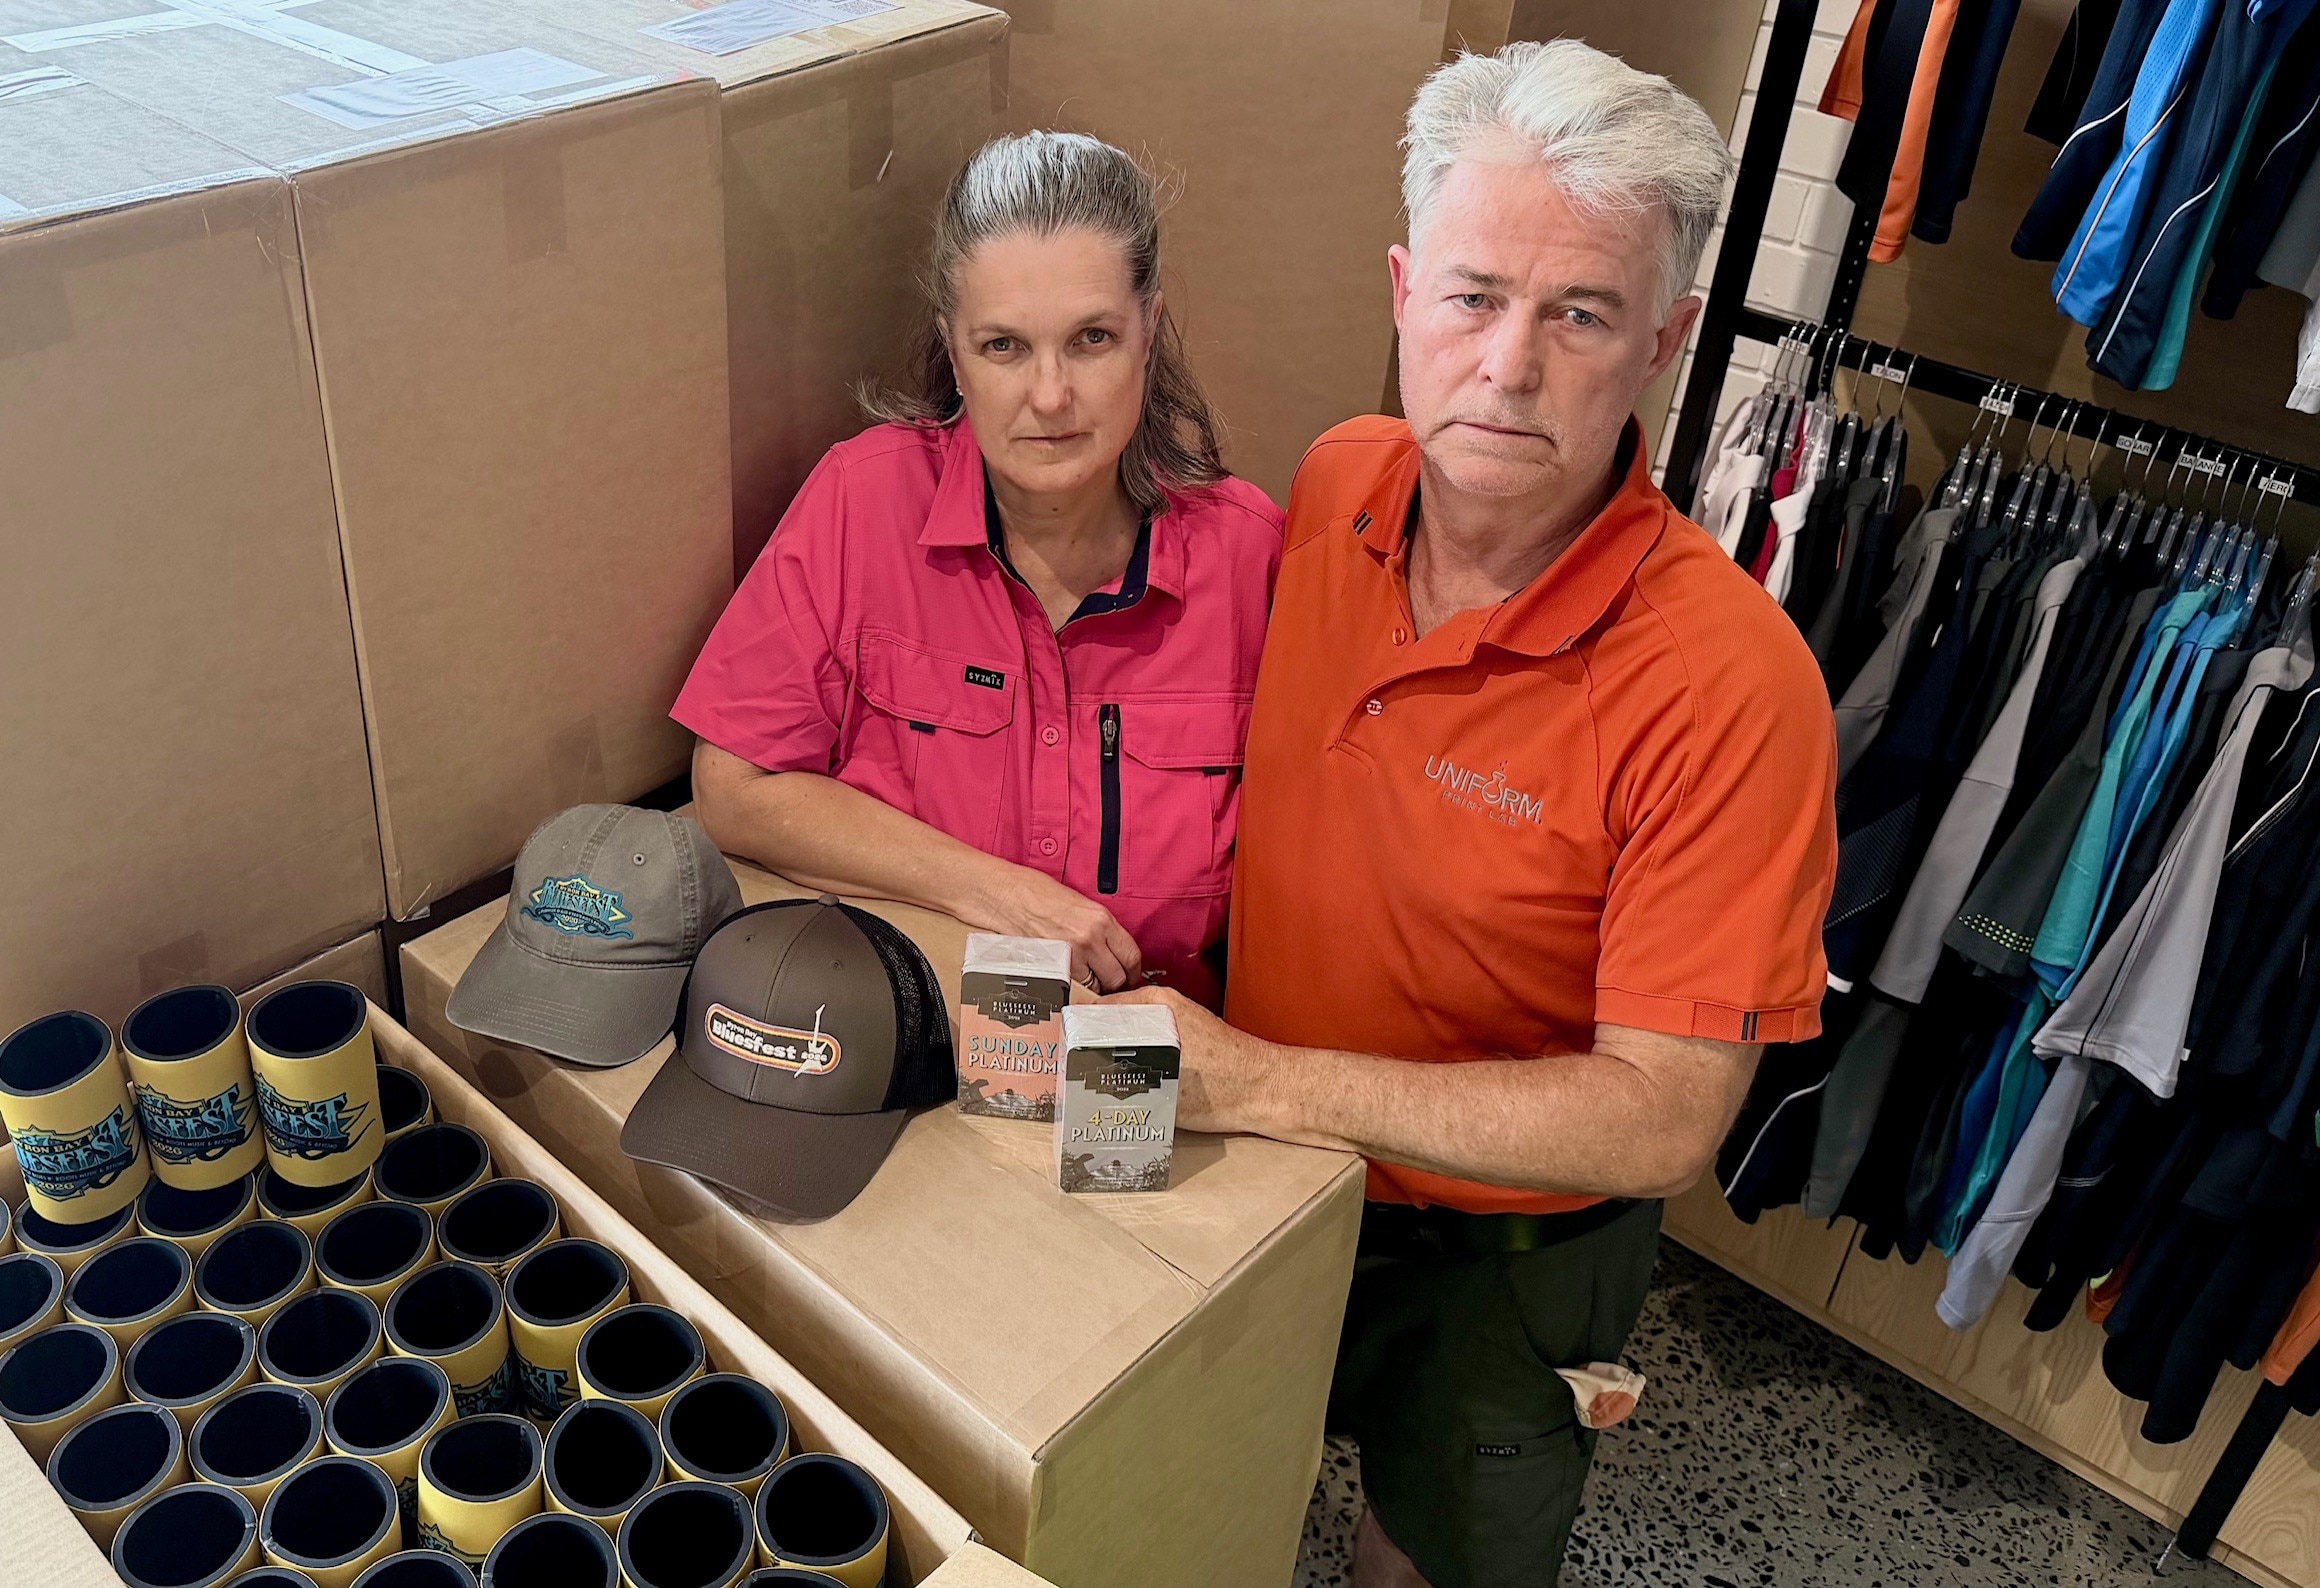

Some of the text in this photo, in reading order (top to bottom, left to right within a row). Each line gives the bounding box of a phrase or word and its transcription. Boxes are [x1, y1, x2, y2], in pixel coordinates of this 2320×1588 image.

[1424, 754, 1543, 824] UNIFORM
[1443, 790, 1484, 815] PRINT
[992, 1007, 1036, 1016] PLATINUM
[712, 1018, 797, 1060] Bluesfest
[969, 1036, 1058, 1058] SUNDAY
[968, 1052, 1058, 1075] PLATINUM
[166, 1109, 193, 1117] BAY
[273, 1101, 297, 1114] BAY
[1088, 1110, 1151, 1126] 4-DAY
[1071, 1127, 1166, 1142] PLATINUM
[54, 1139, 82, 1153] BAY
[36, 1180, 75, 1191] 2026
